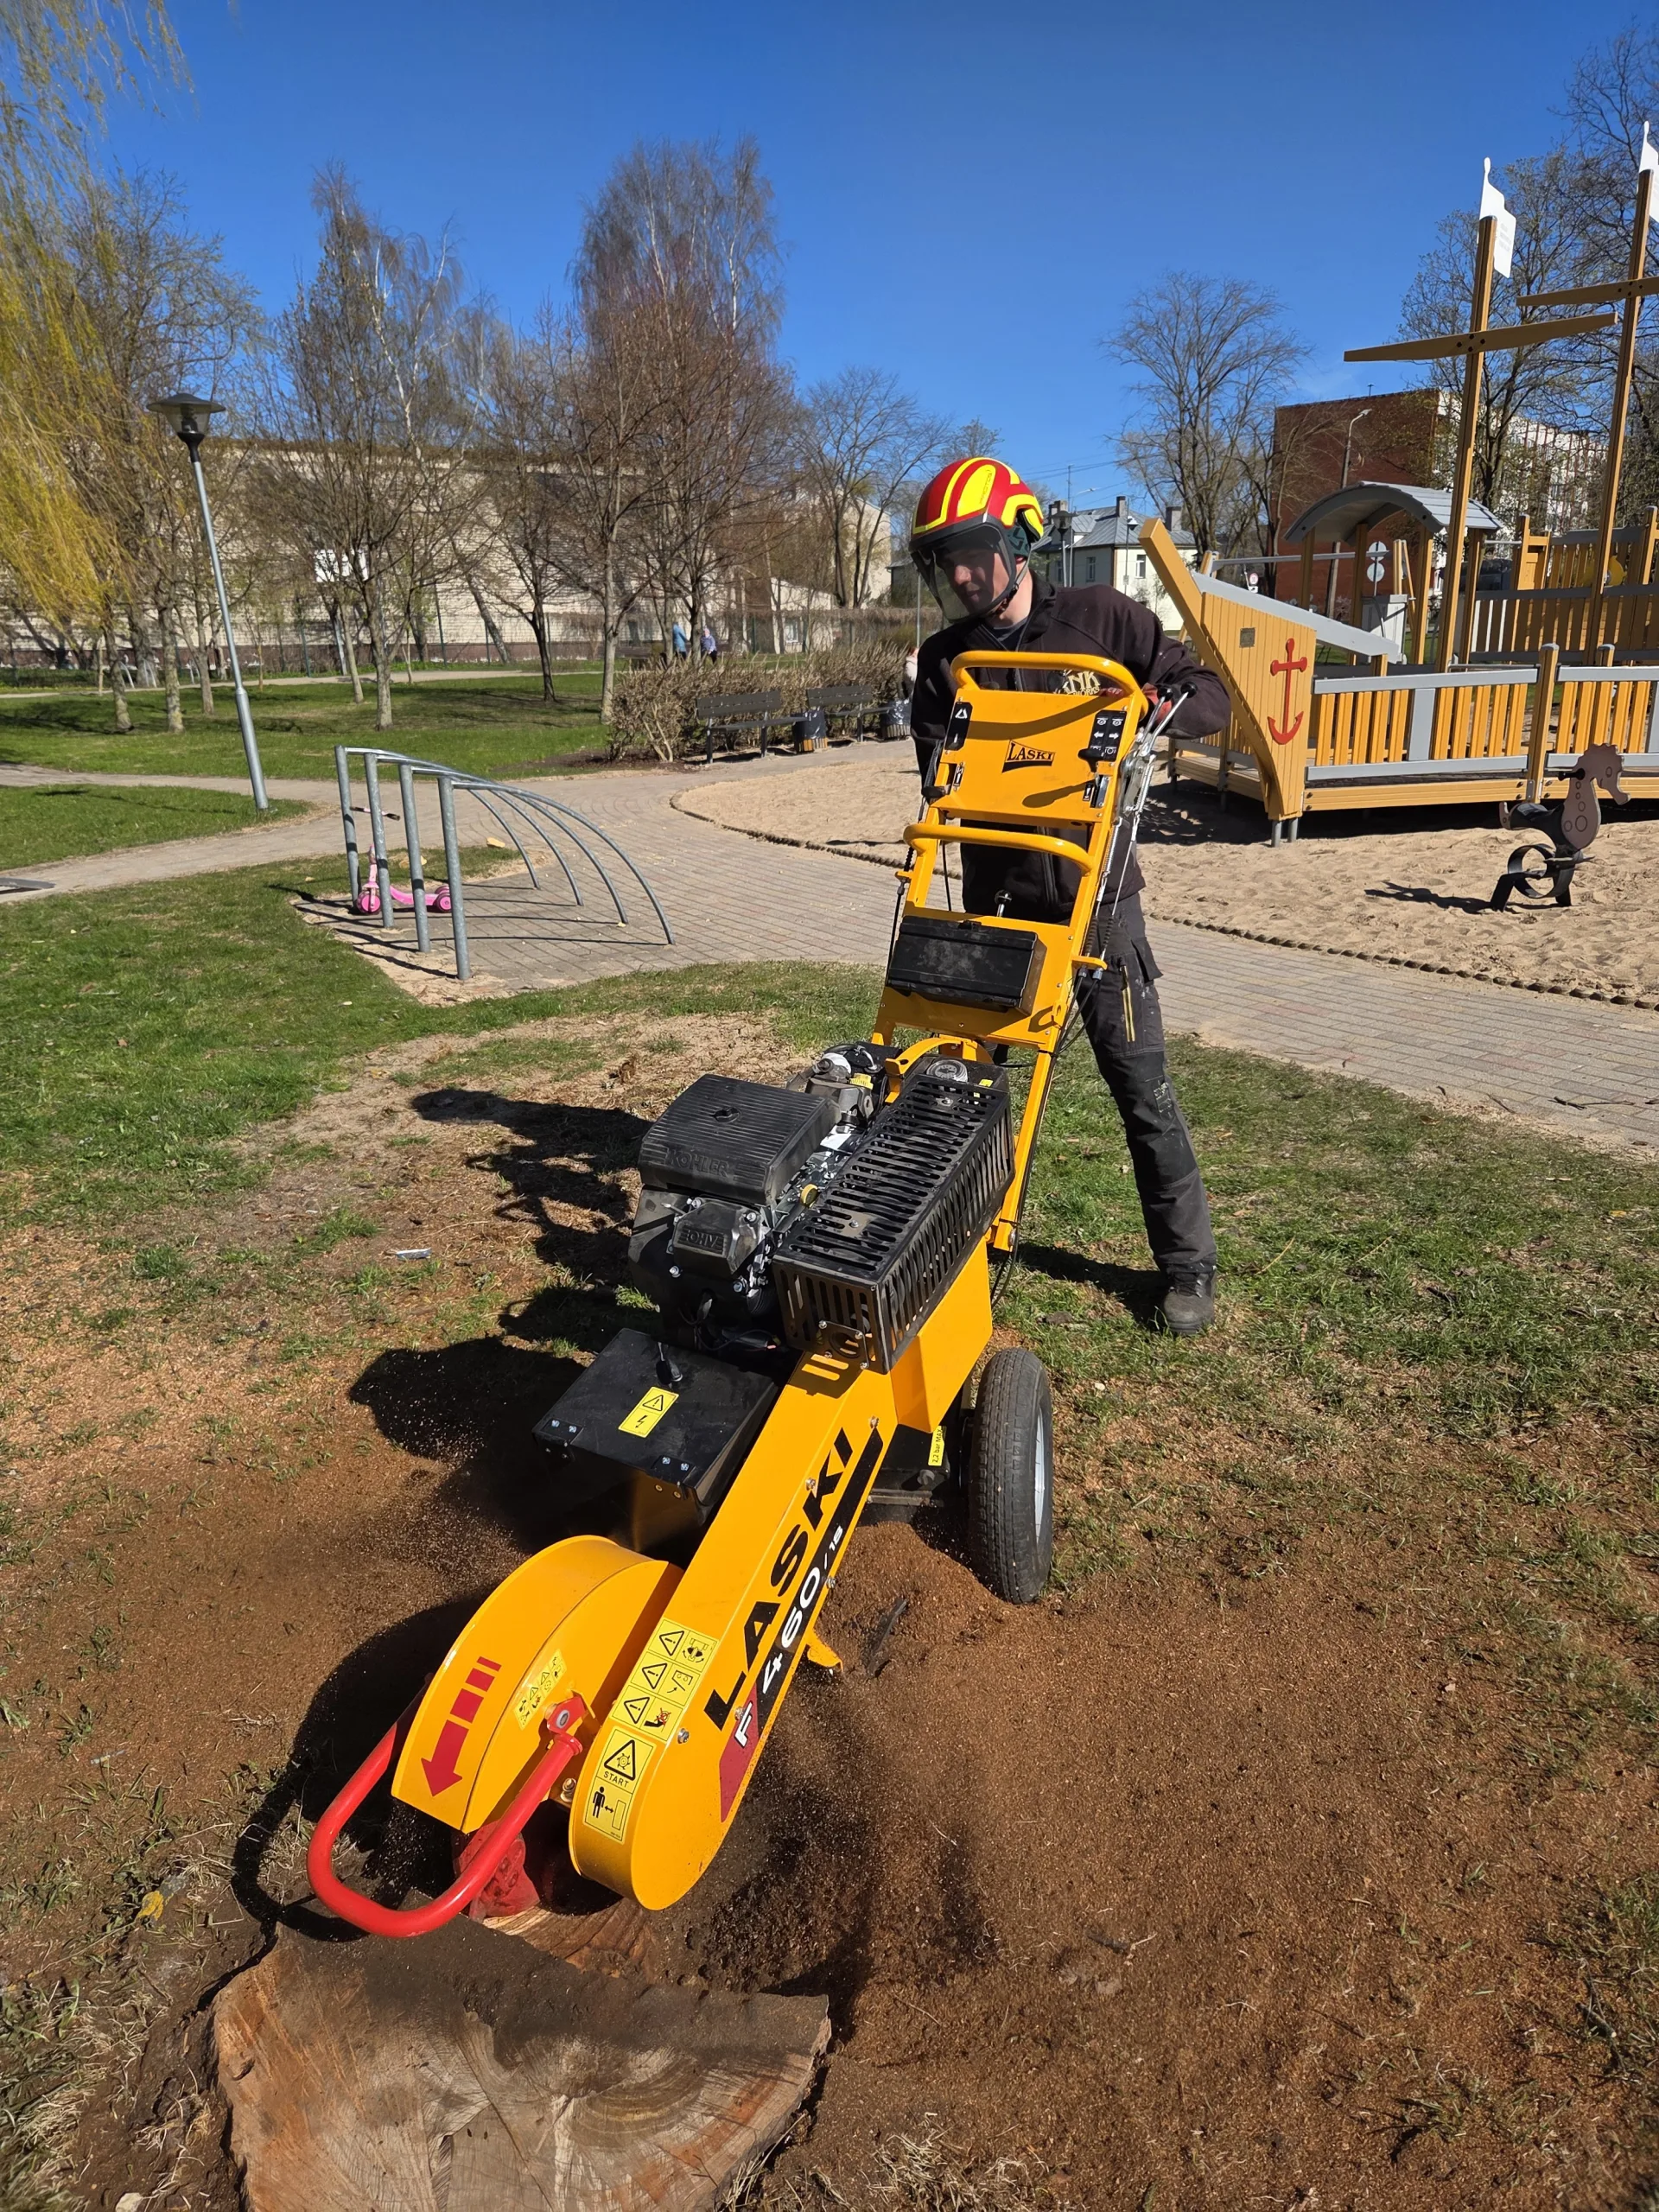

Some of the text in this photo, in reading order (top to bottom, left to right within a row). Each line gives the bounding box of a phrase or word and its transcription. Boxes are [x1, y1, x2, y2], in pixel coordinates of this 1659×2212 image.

[1007, 742, 1053, 760] LASKI
[669, 1148, 730, 1178] KOHLER
[703, 1427, 854, 1732] LASKI
[734, 1700, 753, 1748] F
[603, 1770, 629, 1788] START
